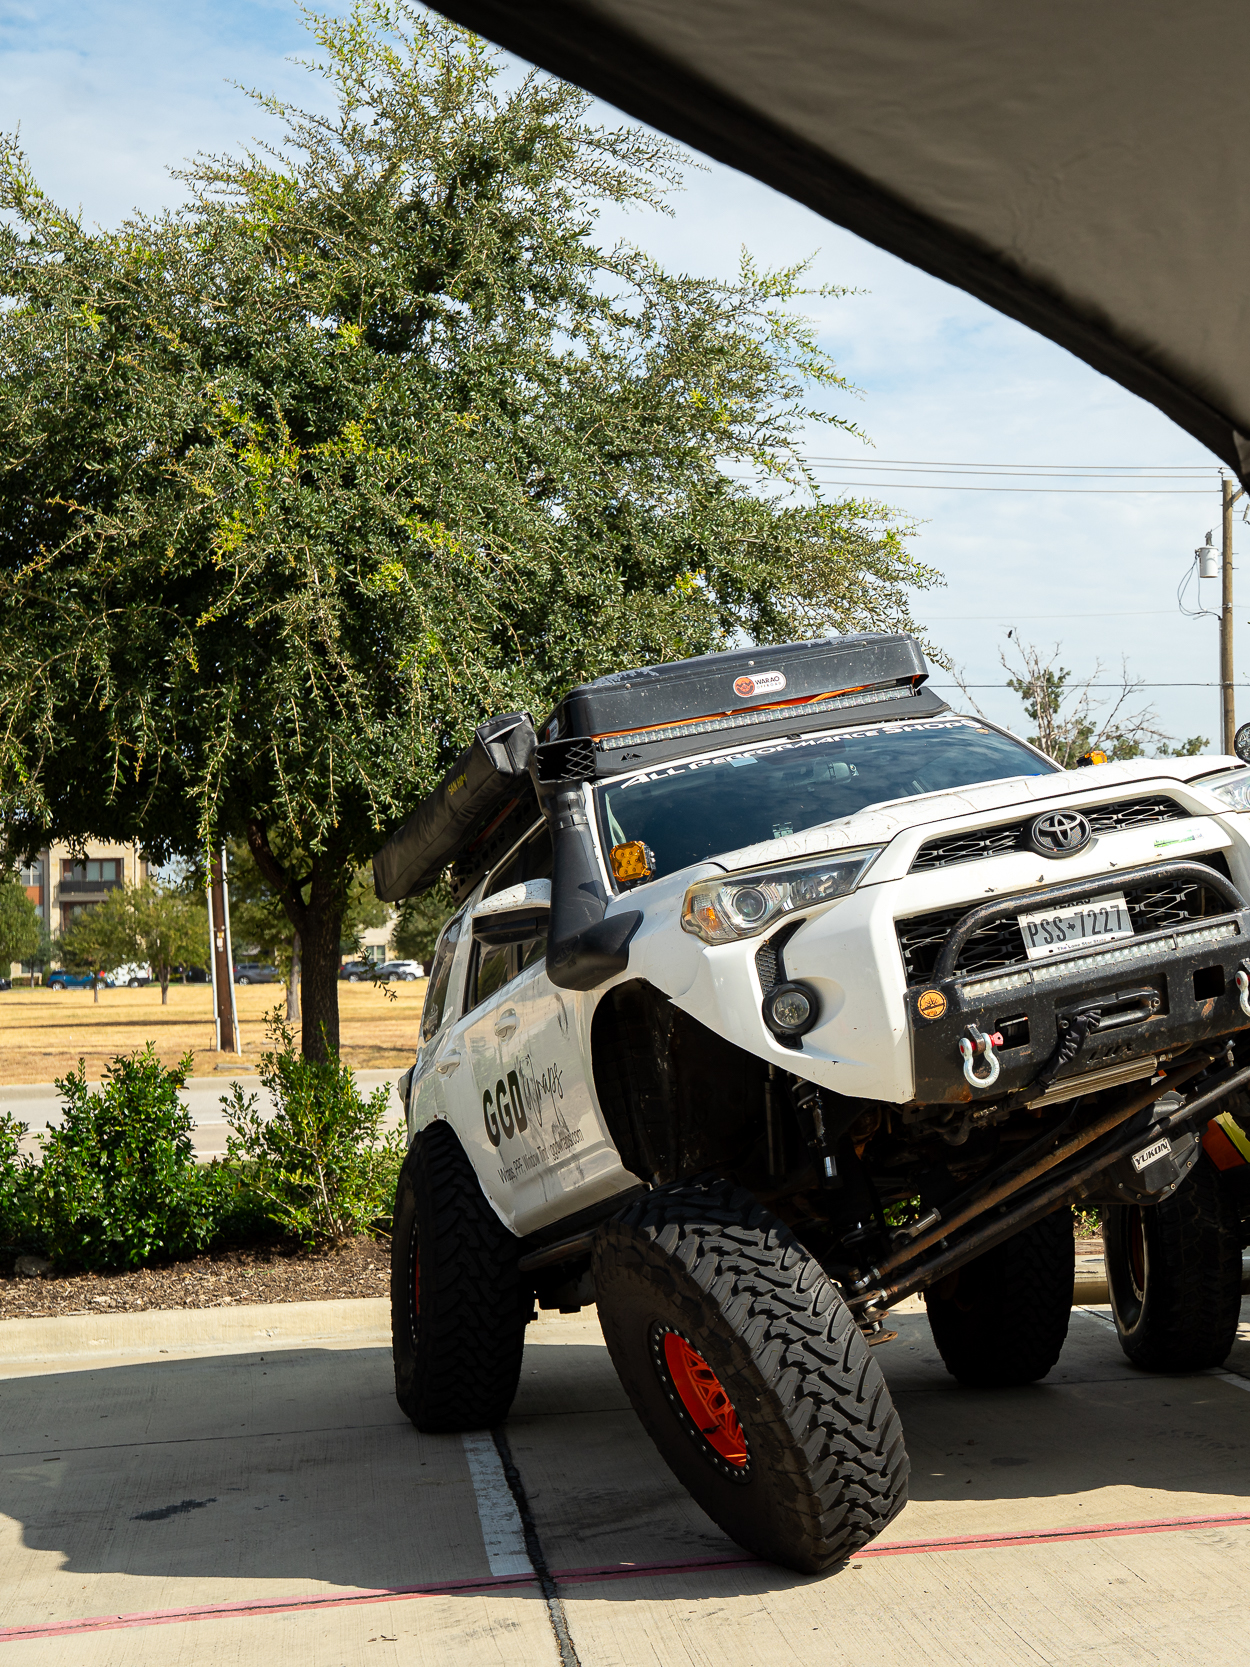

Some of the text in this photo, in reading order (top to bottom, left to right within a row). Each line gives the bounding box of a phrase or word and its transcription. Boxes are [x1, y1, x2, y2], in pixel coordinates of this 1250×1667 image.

[754, 675, 780, 685] WARAO
[620, 721, 965, 790] ALL PERFORMANCE SHOP
[482, 1069, 528, 1148] GGD
[1134, 1141, 1168, 1166] YUKON
